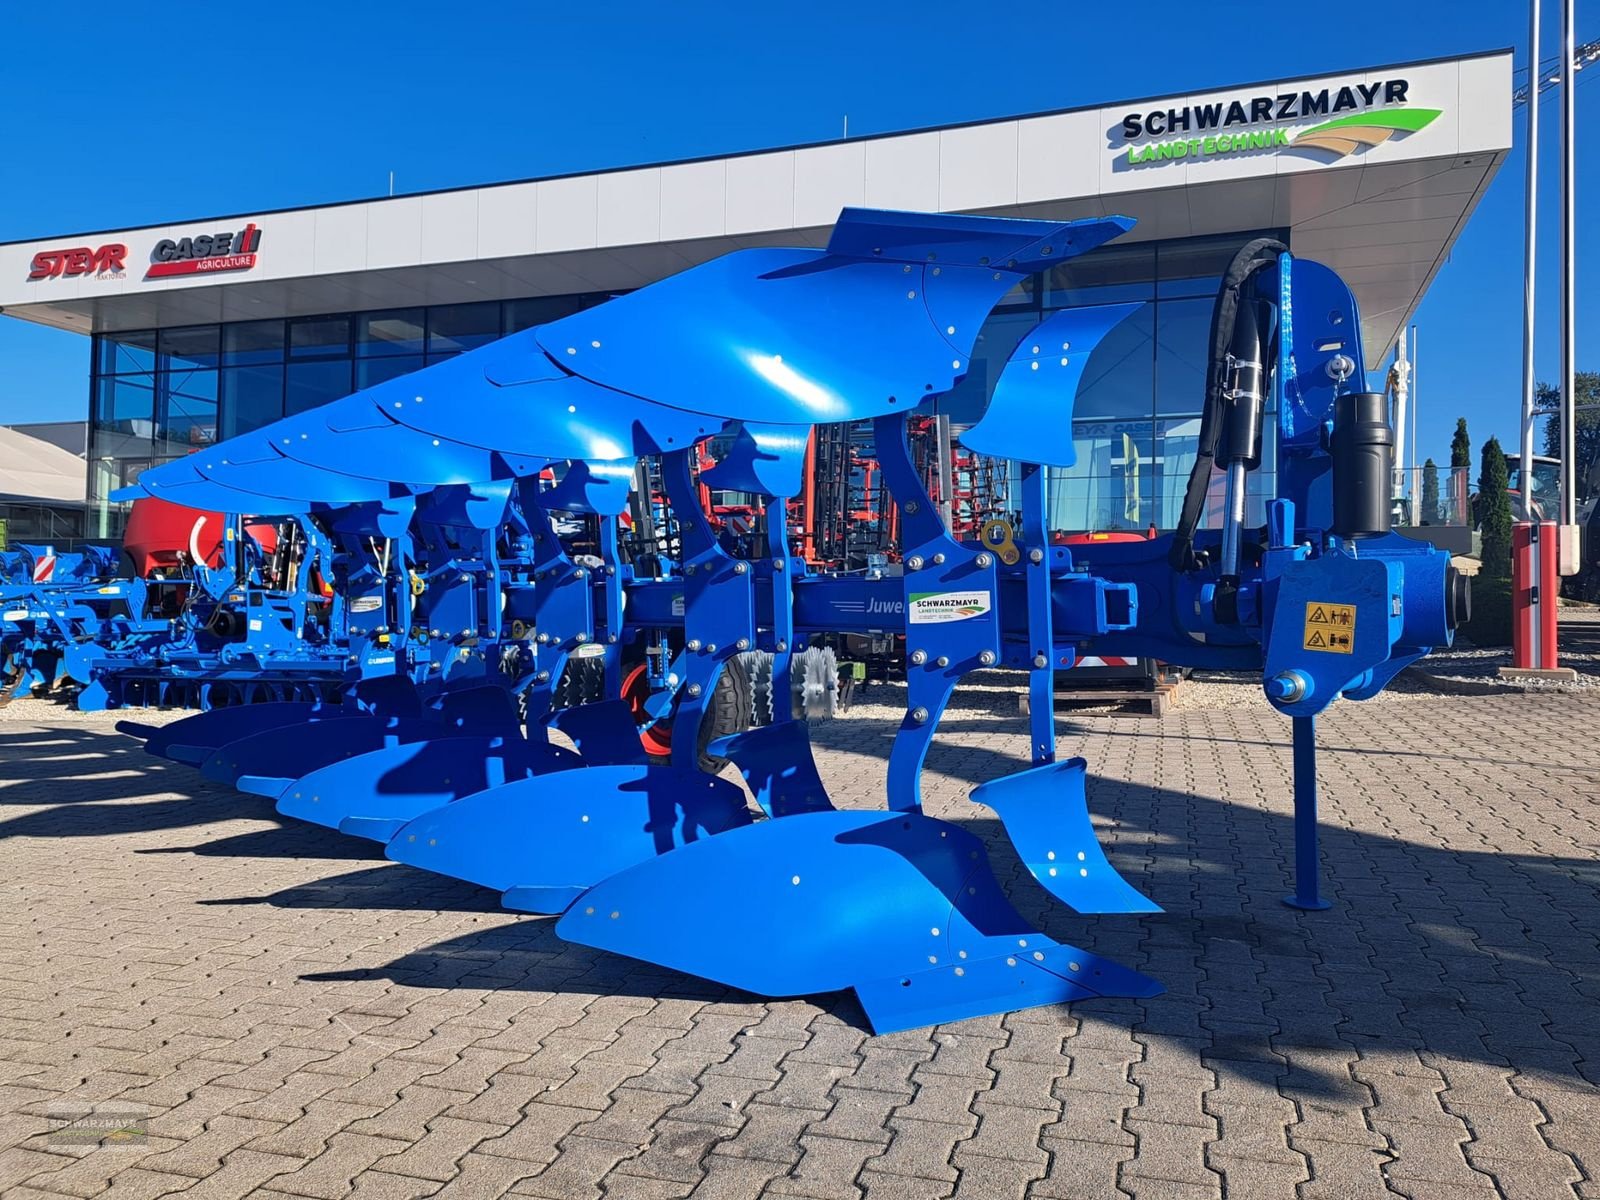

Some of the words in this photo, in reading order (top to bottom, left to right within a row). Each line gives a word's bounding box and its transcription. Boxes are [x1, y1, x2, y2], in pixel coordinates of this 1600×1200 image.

[1122, 79, 1409, 138] SCHWARZMAYR
[1127, 127, 1291, 164] LANDTECHNIK
[29, 243, 127, 279] STEYR
[153, 232, 234, 262] CASE
[196, 256, 251, 270] AGRICULTURE
[916, 598, 979, 608] SCHWARZMAYR
